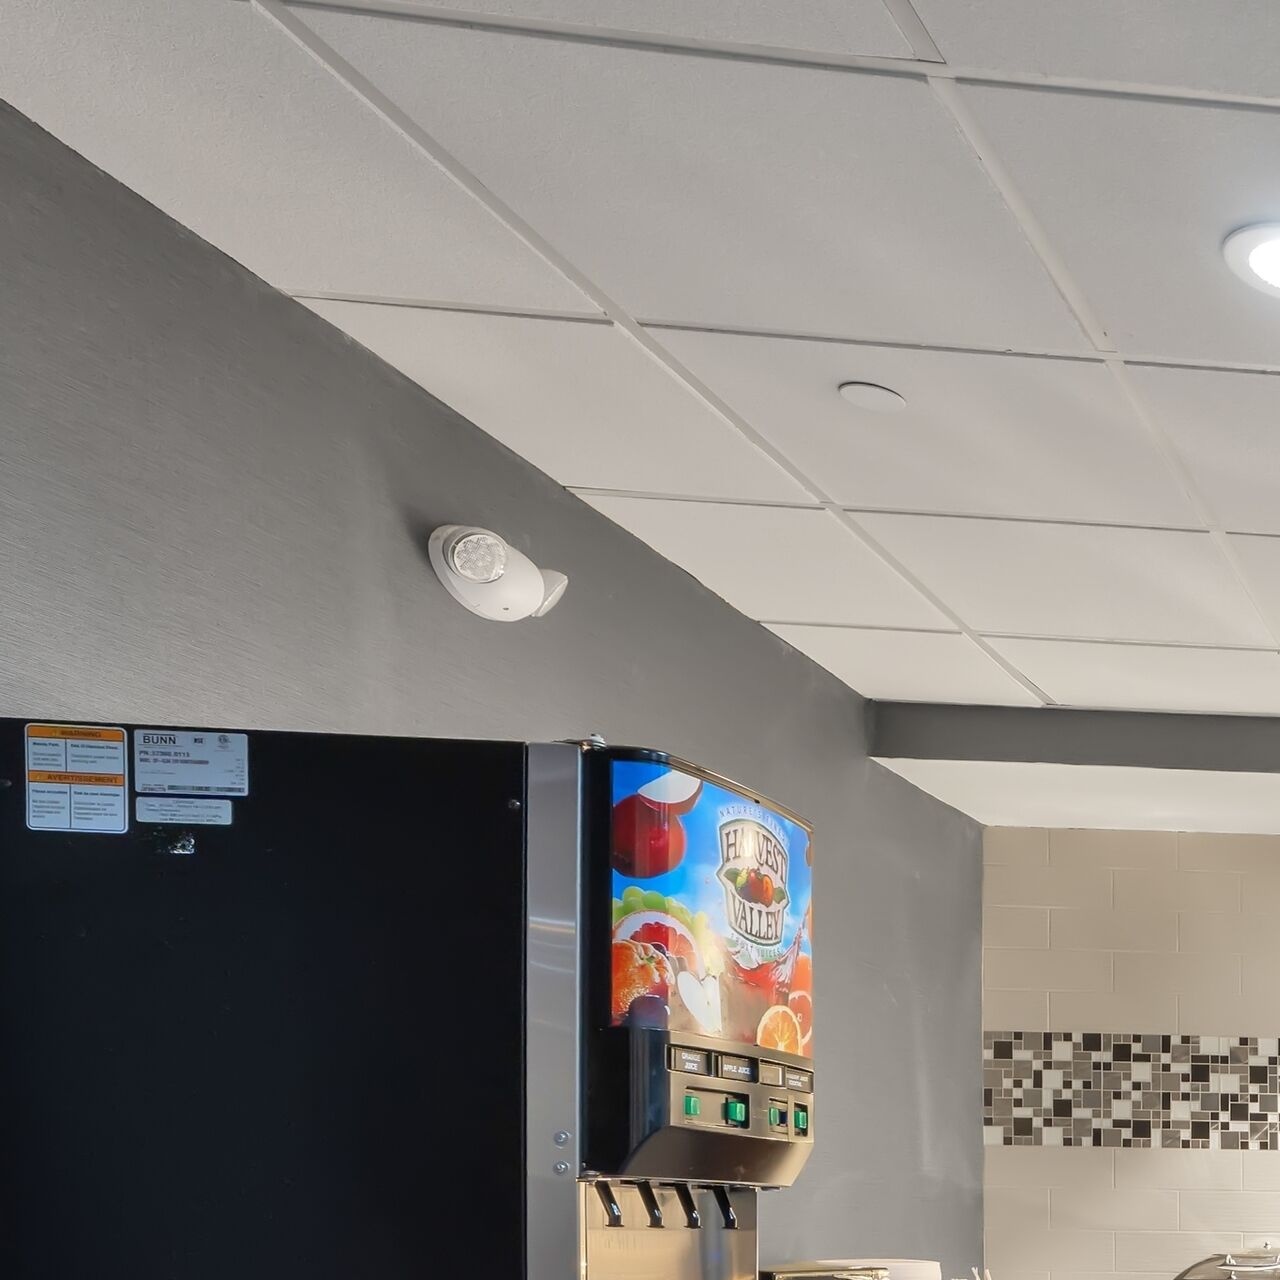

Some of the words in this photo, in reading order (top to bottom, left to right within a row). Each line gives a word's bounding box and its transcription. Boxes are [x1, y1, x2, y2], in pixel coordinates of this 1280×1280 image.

[142, 735, 177, 745] BUNN
[47, 774, 118, 784] AVERTISSEMENT
[724, 827, 786, 884] HAVEST
[730, 889, 781, 941] VALLEY
[681, 1052, 701, 1062] ORANGE
[684, 1062, 698, 1071] JUICE
[723, 1064, 737, 1073] APPLE
[737, 1066, 751, 1075] JUICE
